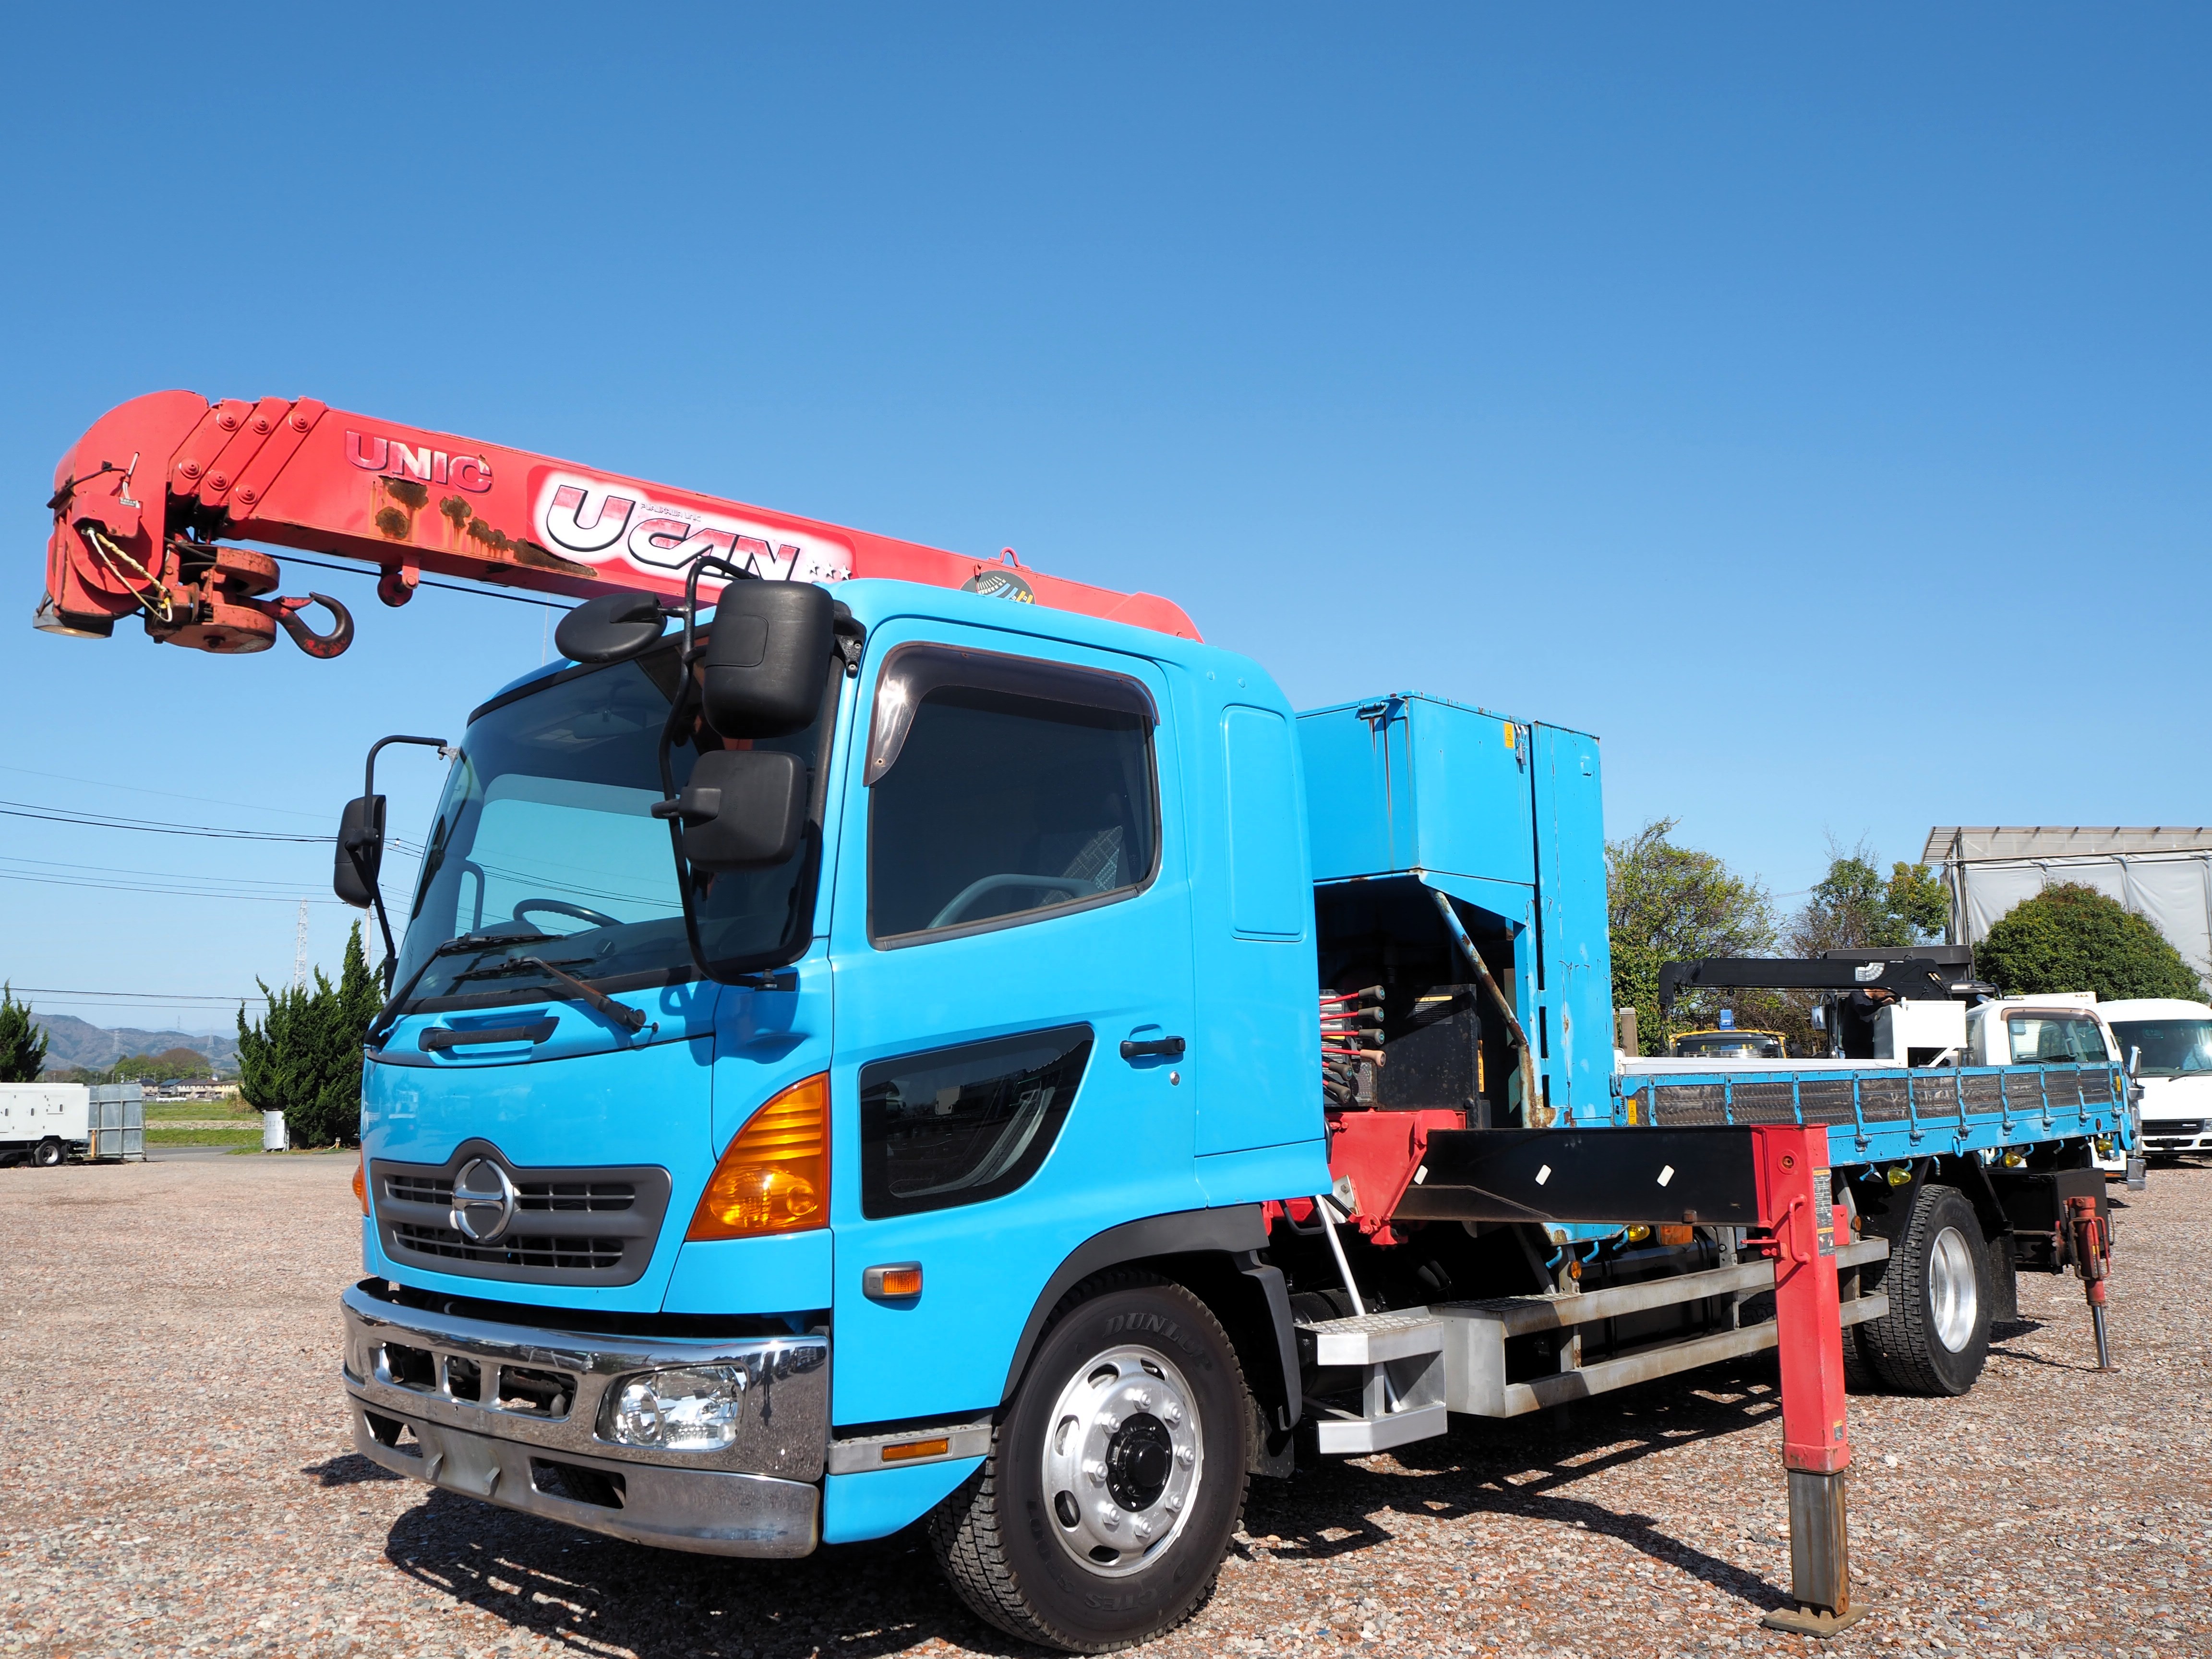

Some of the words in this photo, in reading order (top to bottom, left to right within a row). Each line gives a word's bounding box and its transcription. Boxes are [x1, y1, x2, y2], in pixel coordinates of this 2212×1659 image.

[345, 431, 493, 493] UNIC
[546, 484, 800, 581] UCAN
[640, 503, 683, 518] FURUKAWA
[1102, 1311, 1213, 1371] DUNLOP
